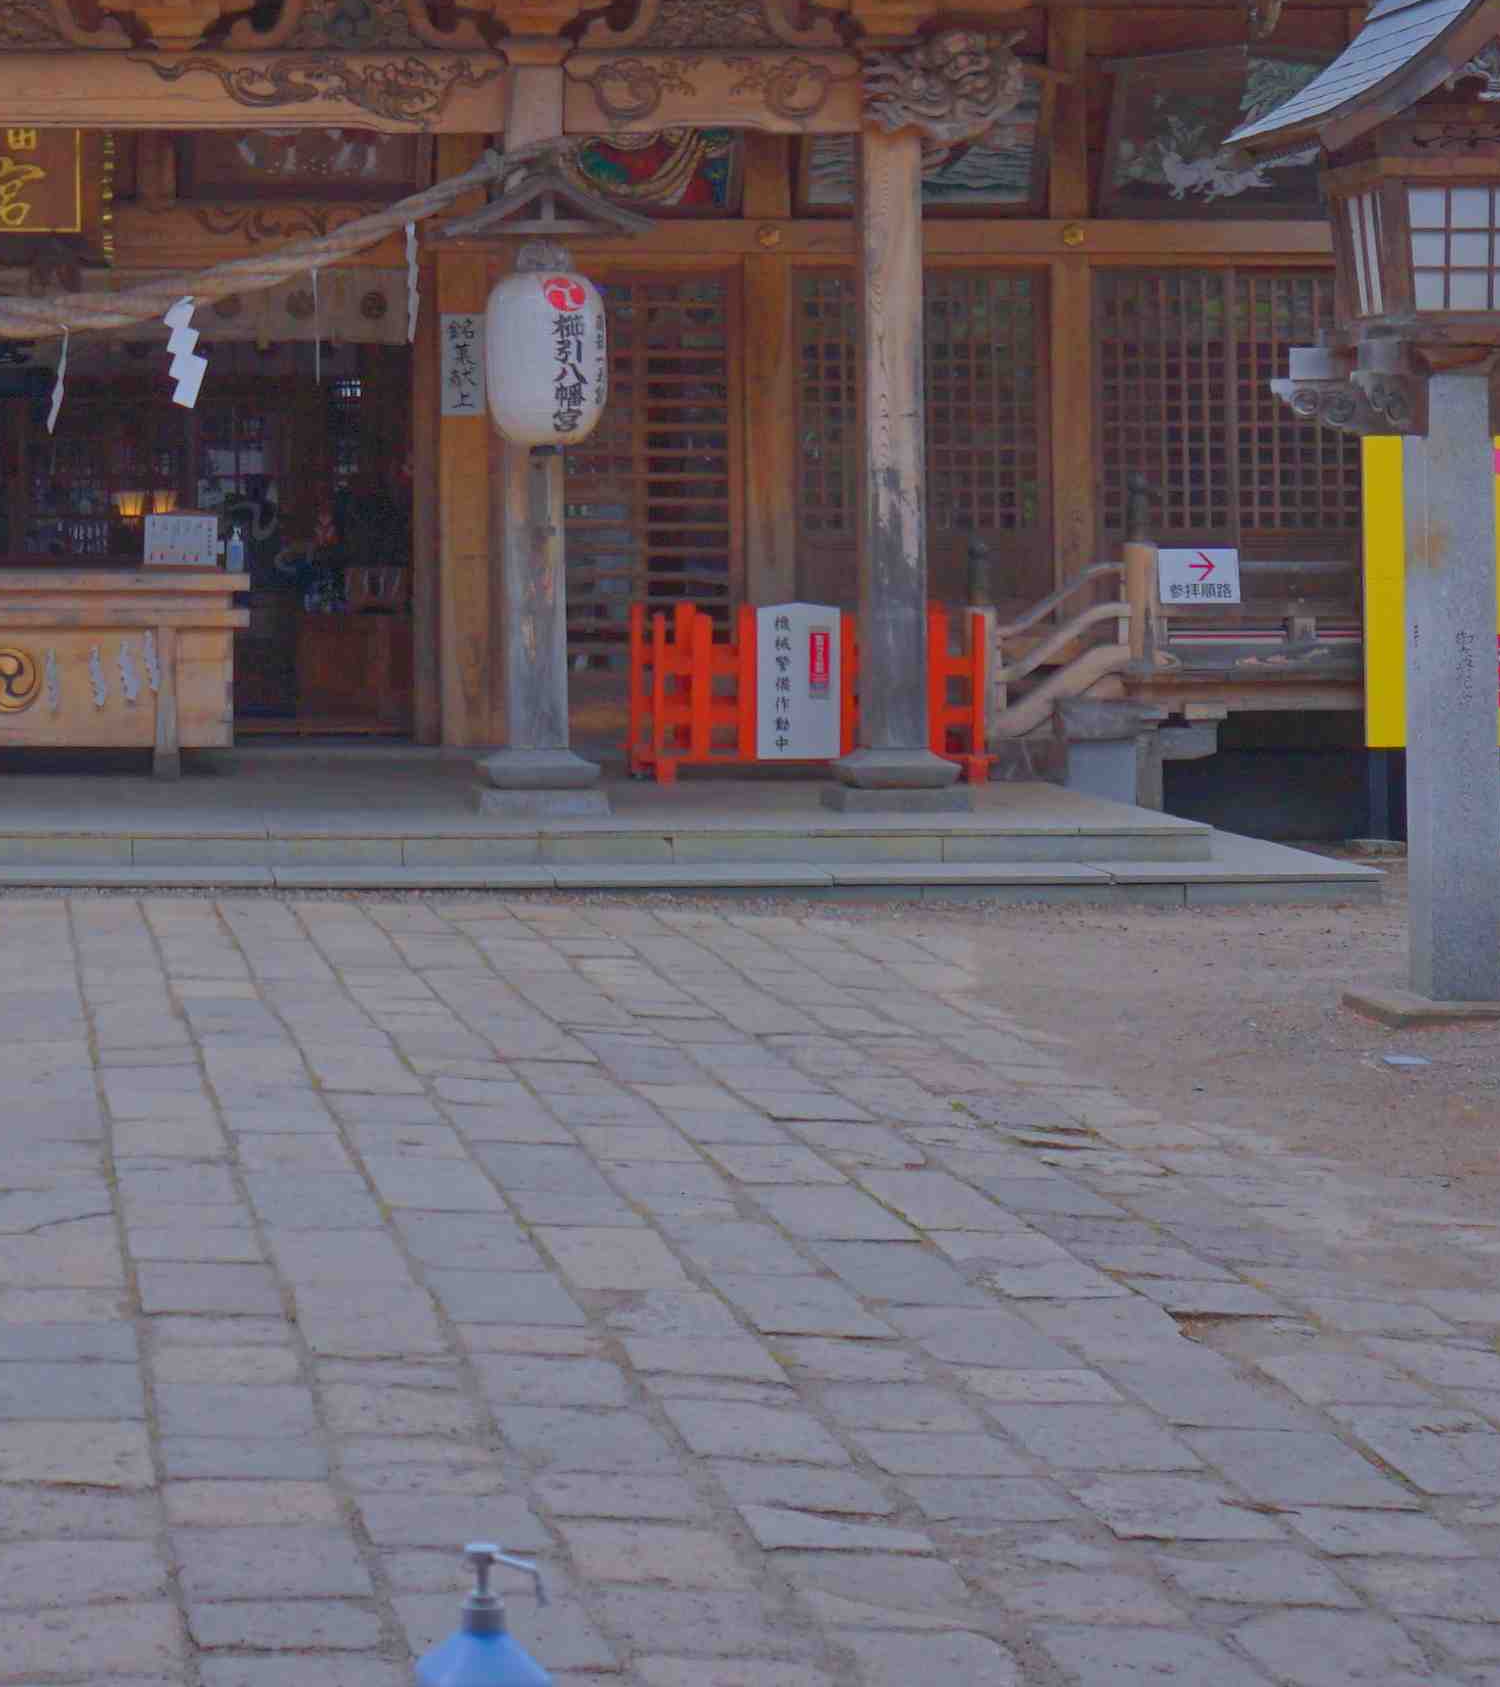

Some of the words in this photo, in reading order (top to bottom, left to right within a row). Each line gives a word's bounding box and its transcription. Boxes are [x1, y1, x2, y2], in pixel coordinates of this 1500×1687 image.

[552, 314, 588, 432] 櫛引八幡宮
[1169, 583, 1233, 599] 参拝順路
[774, 615, 791, 753] 機械警備作動中
